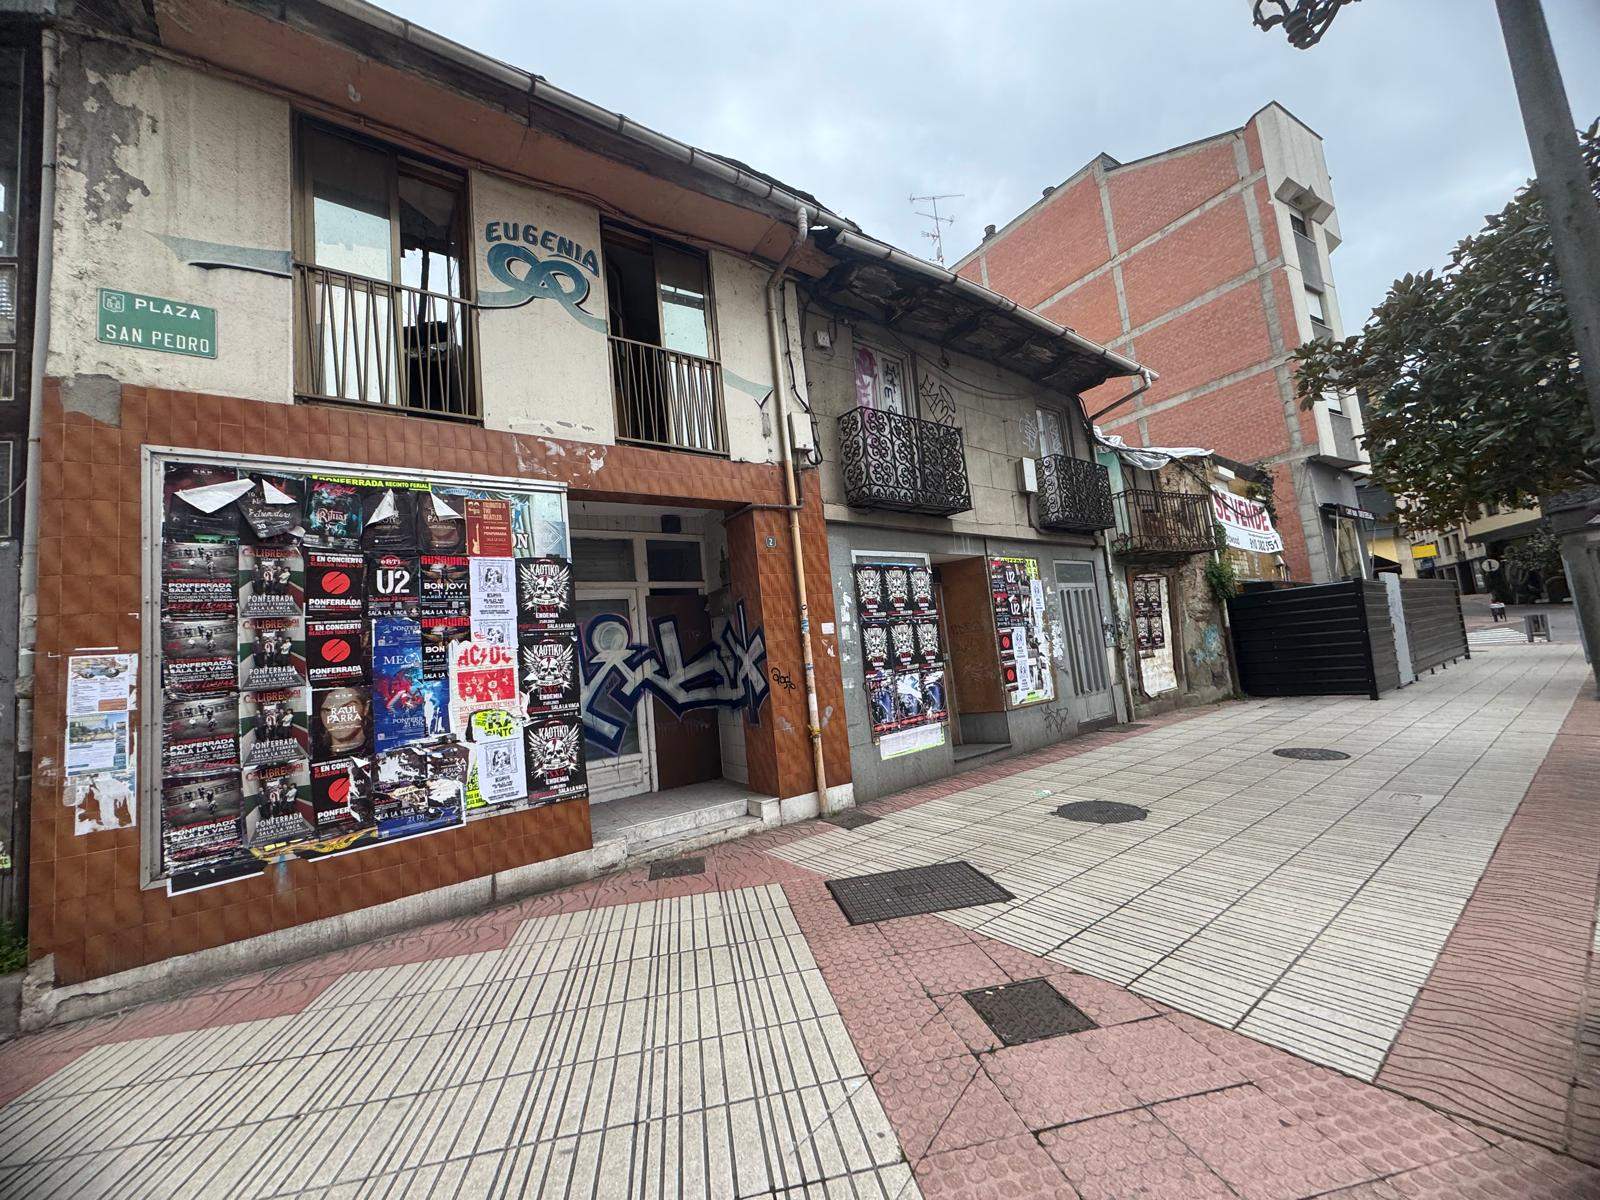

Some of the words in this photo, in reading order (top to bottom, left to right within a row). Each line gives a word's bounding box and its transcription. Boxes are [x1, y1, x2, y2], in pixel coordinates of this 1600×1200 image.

[485, 221, 600, 278] EUGENIA
[135, 298, 200, 320] PLAZA
[106, 324, 142, 343] SAN
[152, 331, 209, 353] PEDRO
[1214, 489, 1231, 521] SE
[1229, 497, 1269, 531] VENDE
[530, 564, 559, 576] KAOTIKO
[1006, 570, 1016, 583] U2
[376, 569, 410, 594] U2
[445, 583, 467, 591] JOVI
[1011, 603, 1021, 615] U2
[425, 645, 445, 653] BON
[533, 644, 563, 657] KAOTIKO
[169, 660, 233, 669] PONFERRADA
[249, 665, 296, 674] PONFERRADA
[310, 665, 362, 675] PONFERRADA
[327, 713, 362, 724] PARRA
[539, 725, 569, 739] KAOTIKO
[170, 738, 235, 751] PONFERRADA
[251, 738, 298, 750] PONFERRADA
[256, 812, 303, 828] PONFERRADA
[171, 820, 236, 835] PONFERRADA
